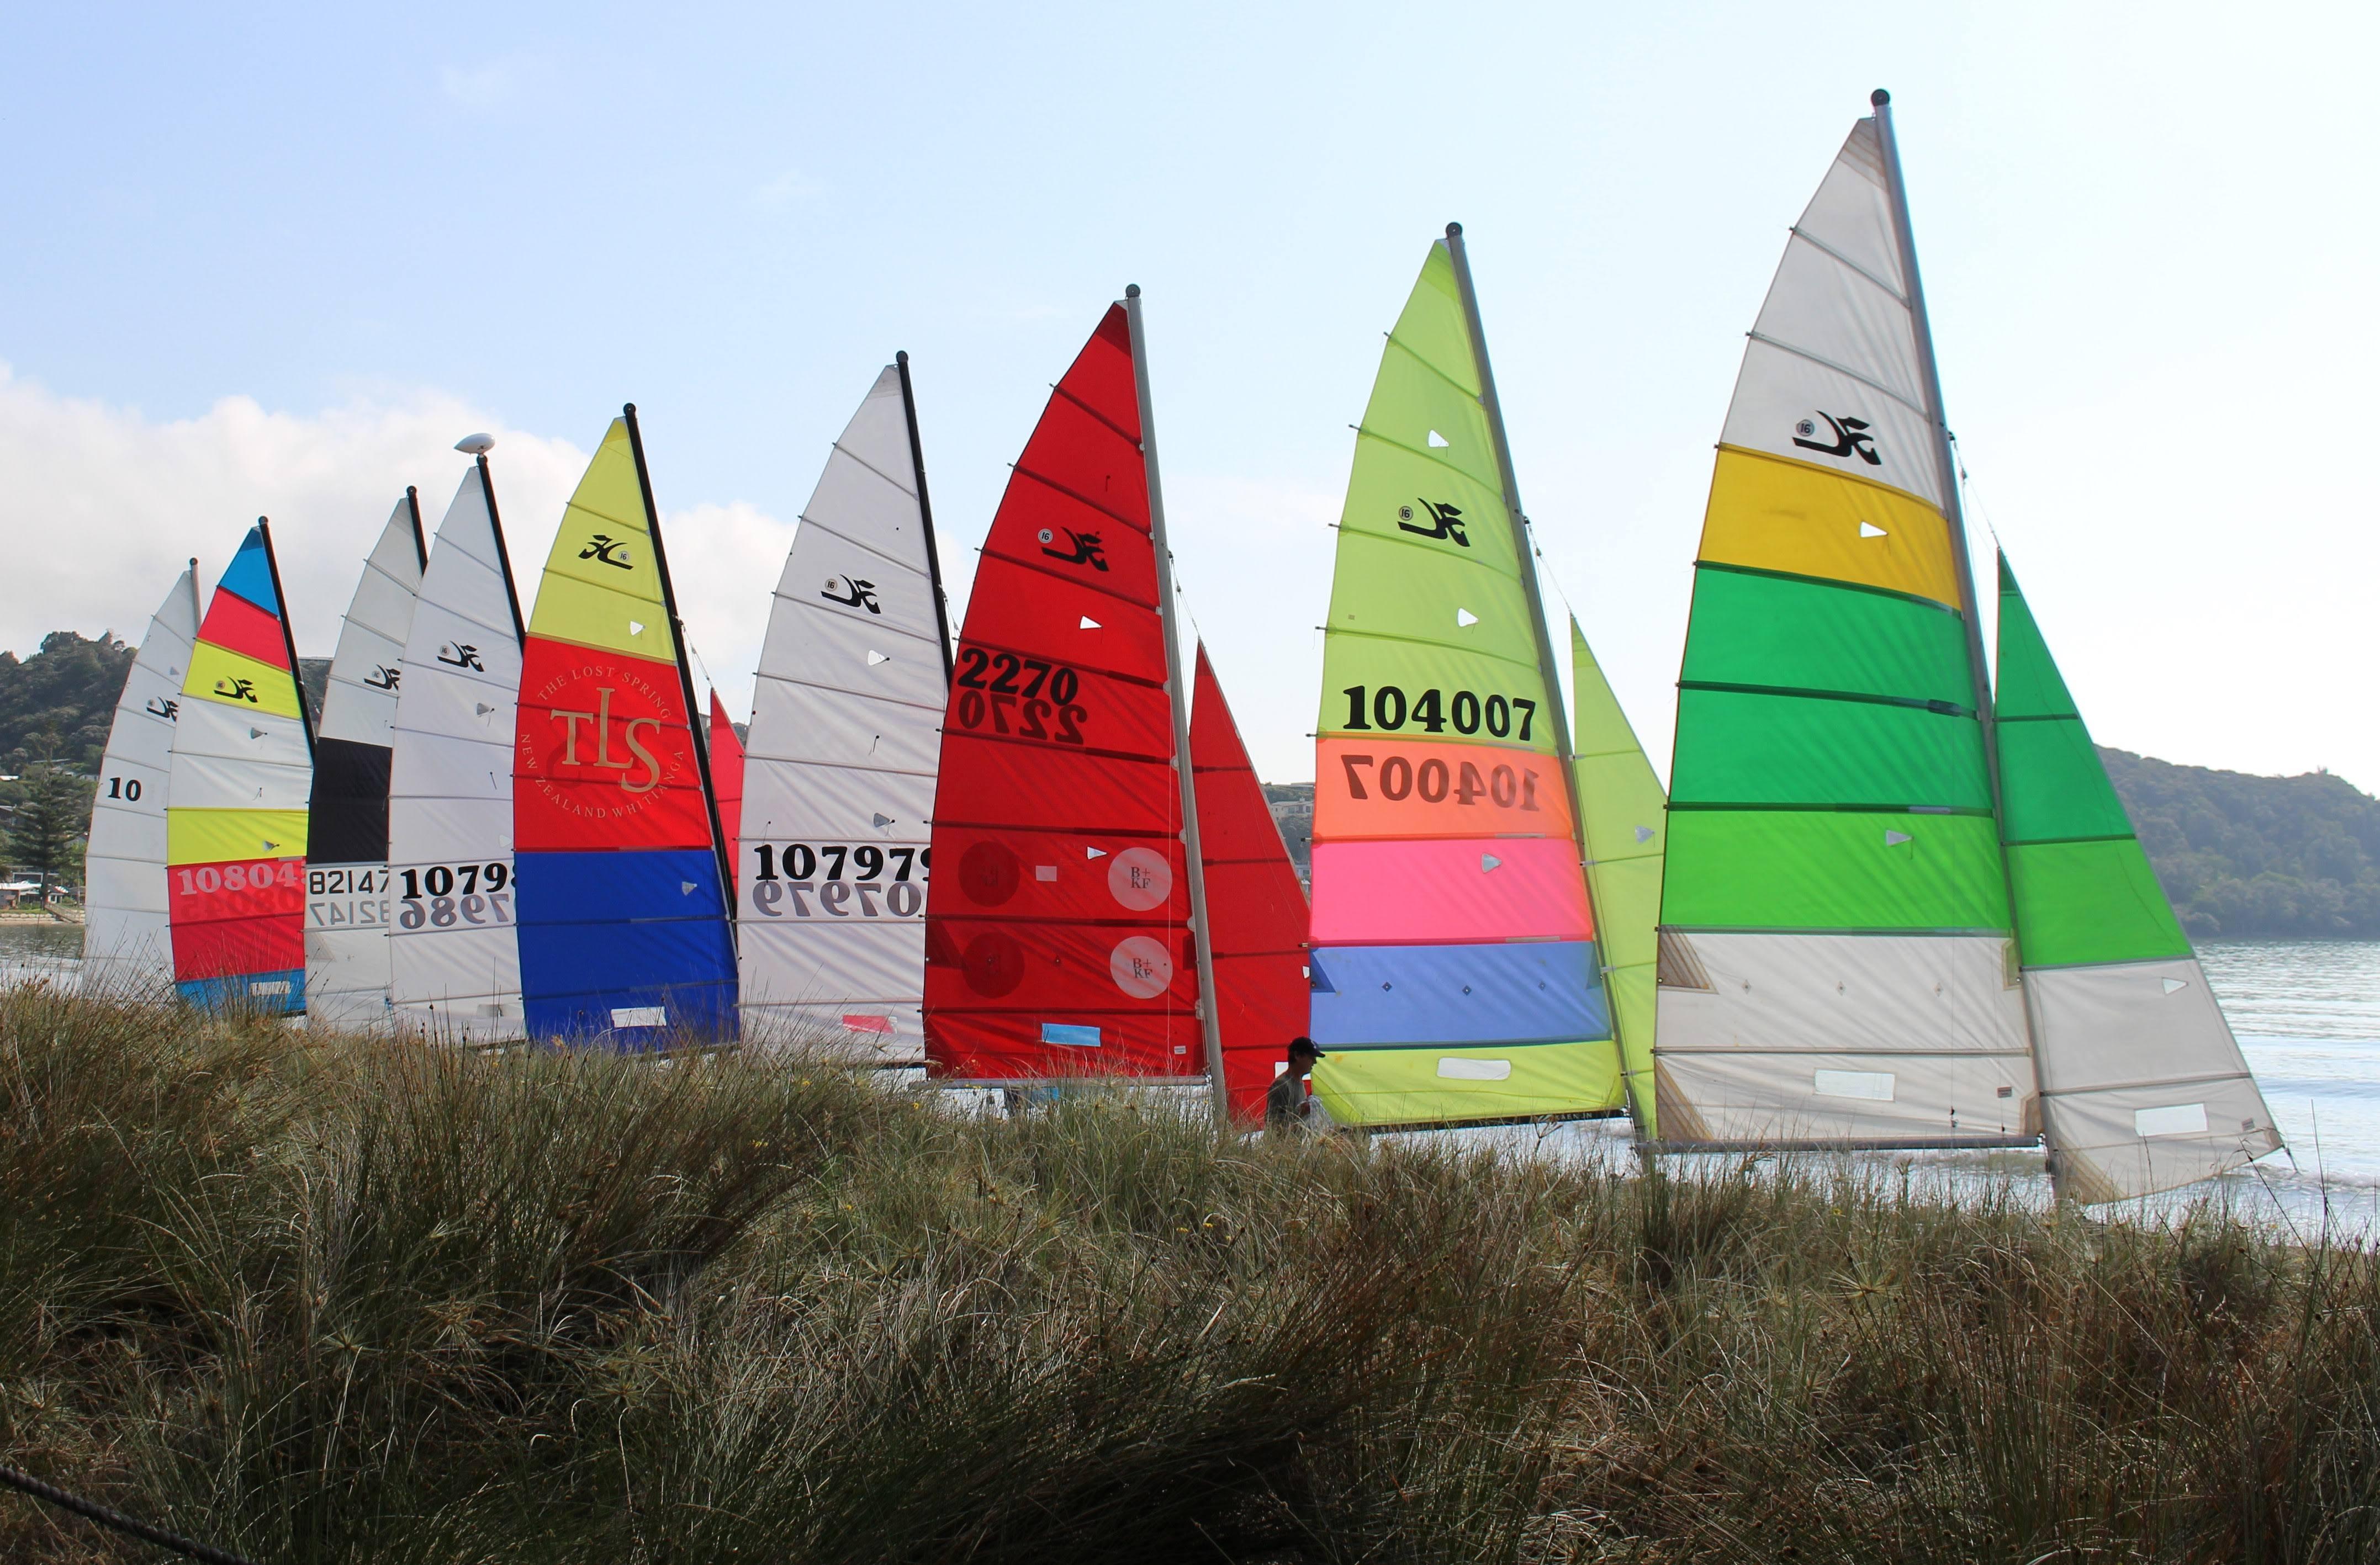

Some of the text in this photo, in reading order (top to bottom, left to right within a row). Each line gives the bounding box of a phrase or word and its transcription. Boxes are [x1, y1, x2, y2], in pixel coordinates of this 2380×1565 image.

[1801, 423, 1811, 433] 16
[1401, 508, 1410, 518] 16
[1041, 532, 1050, 540] 16
[827, 581, 835, 589] 16
[957, 648, 1078, 707] 2270
[538, 666, 671, 719] THE LOST SPRING
[1343, 686, 1536, 741] 104007
[549, 687, 660, 793] TLS
[521, 734, 684, 818] NEW ZEALAND WHITIANGA
[108, 777, 141, 802] 10
[178, 861, 305, 895] 10804
[309, 869, 389, 895] 82147
[400, 863, 516, 899] 1079
[1131, 878, 1151, 889] KF
[1135, 968, 1152, 978] KF
